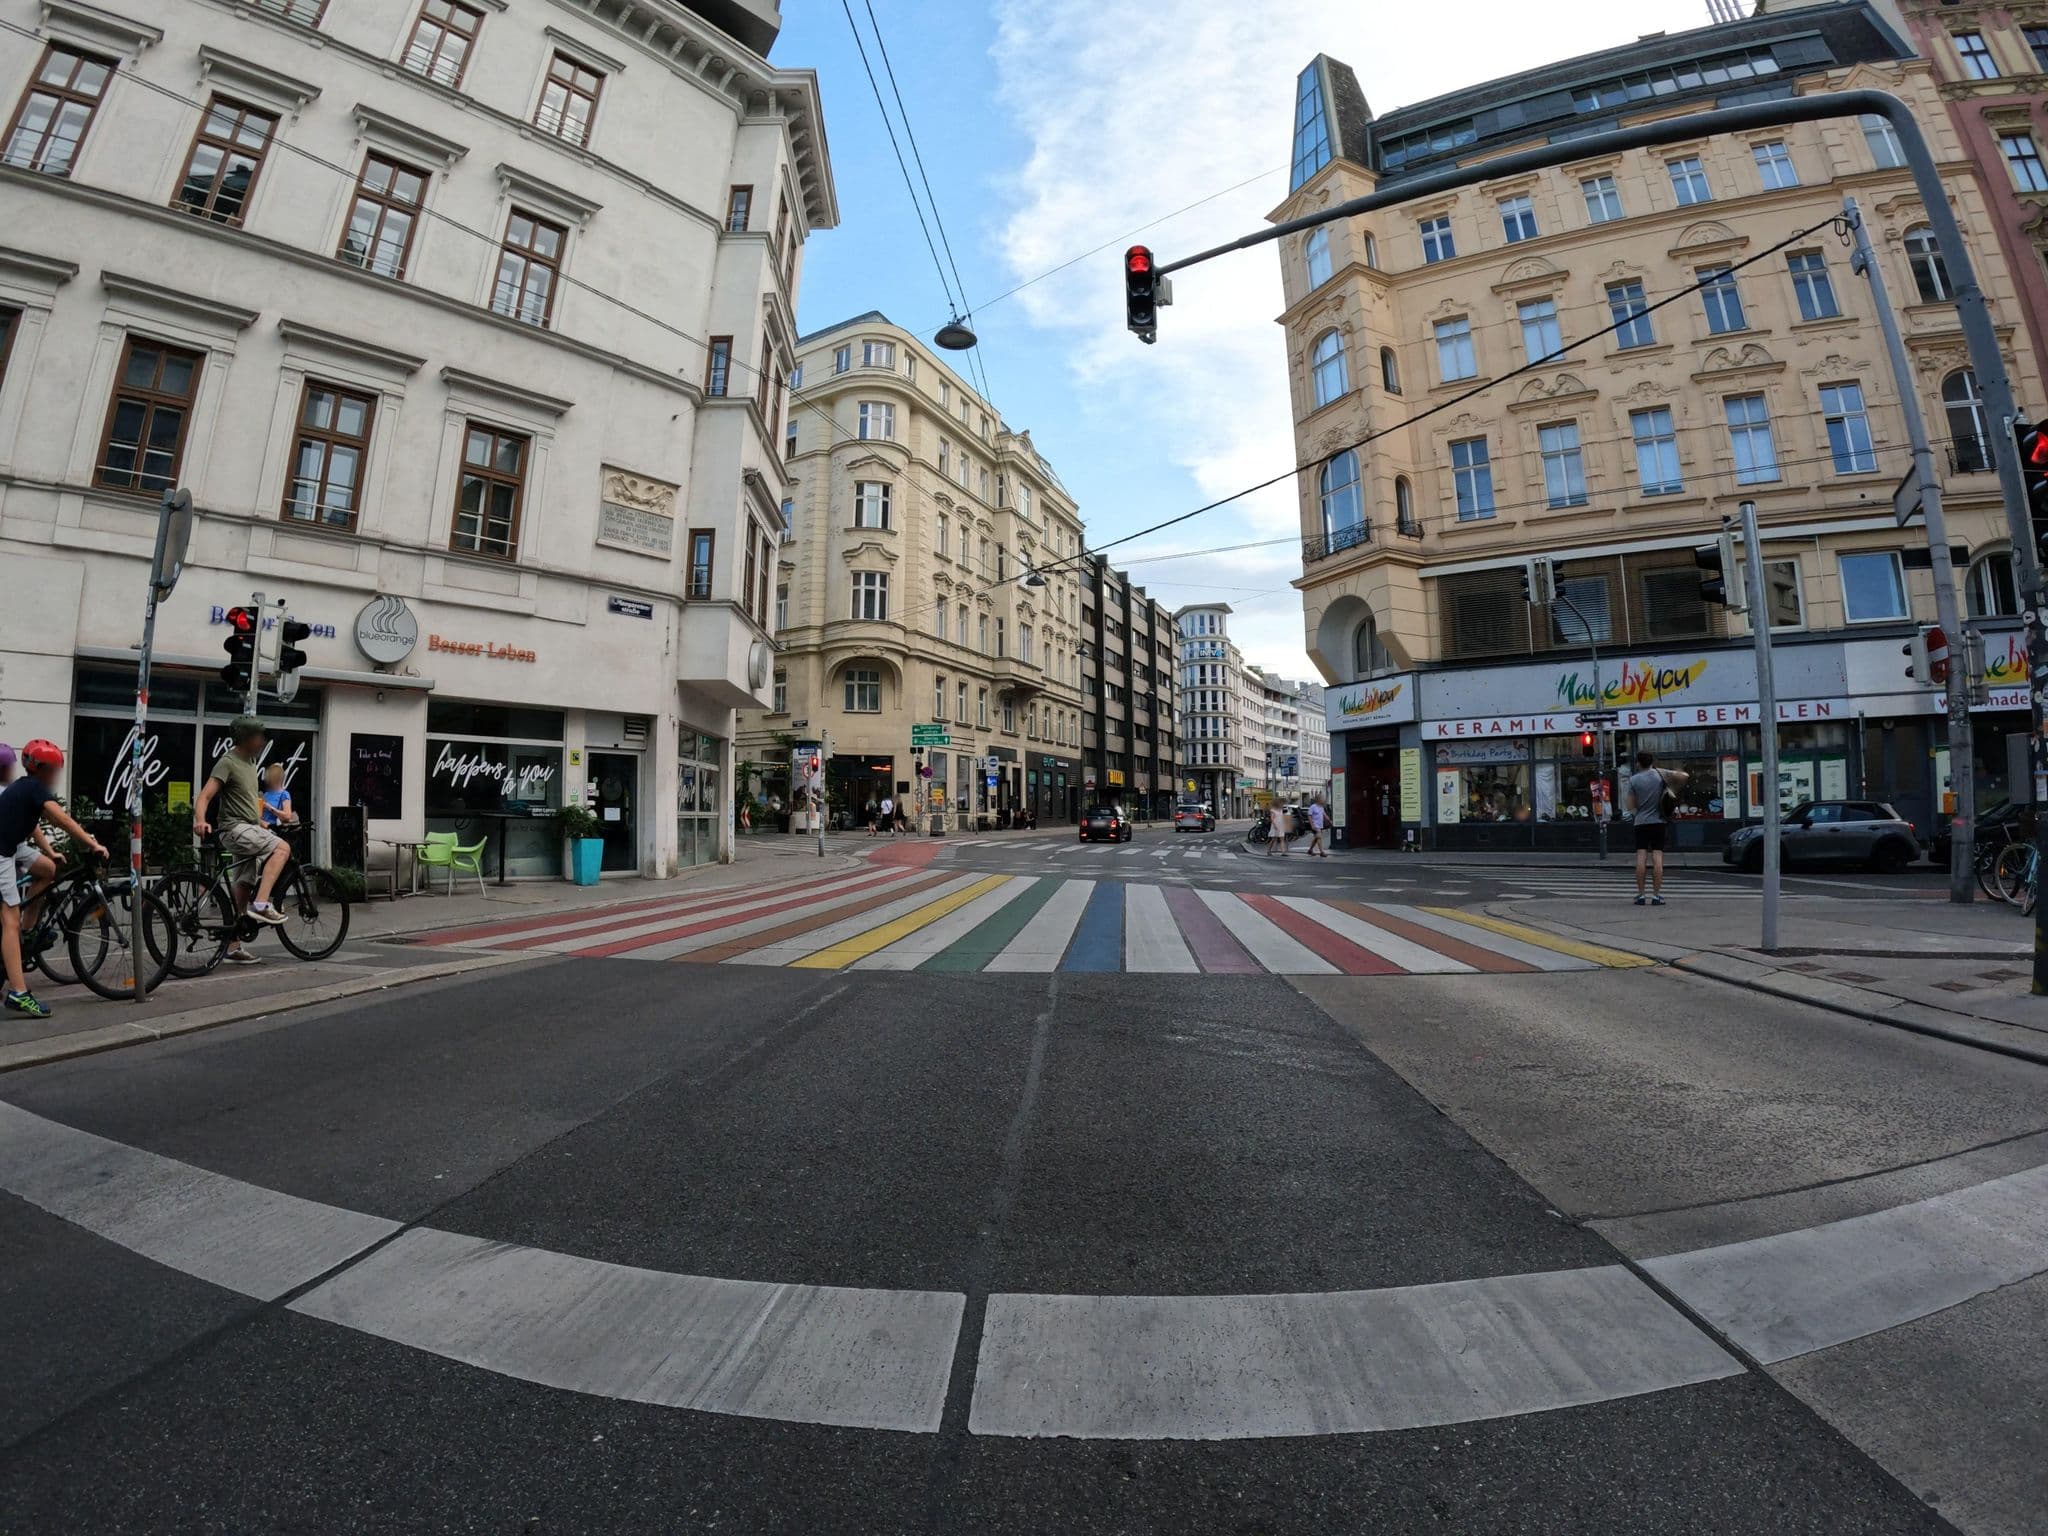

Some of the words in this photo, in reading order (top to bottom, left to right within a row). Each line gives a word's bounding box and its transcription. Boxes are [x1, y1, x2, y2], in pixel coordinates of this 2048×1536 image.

[359, 630, 415, 645] blueorange
[428, 634, 483, 657] Besser
[487, 641, 536, 663] Leben
[1438, 718, 1555, 736] KERAMIK
[1575, 711, 1677, 729] SBST
[1697, 703, 1831, 723] BEMLEN
[432, 742, 507, 788] happens
[501, 769, 517, 796] to
[520, 764, 555, 791] you
